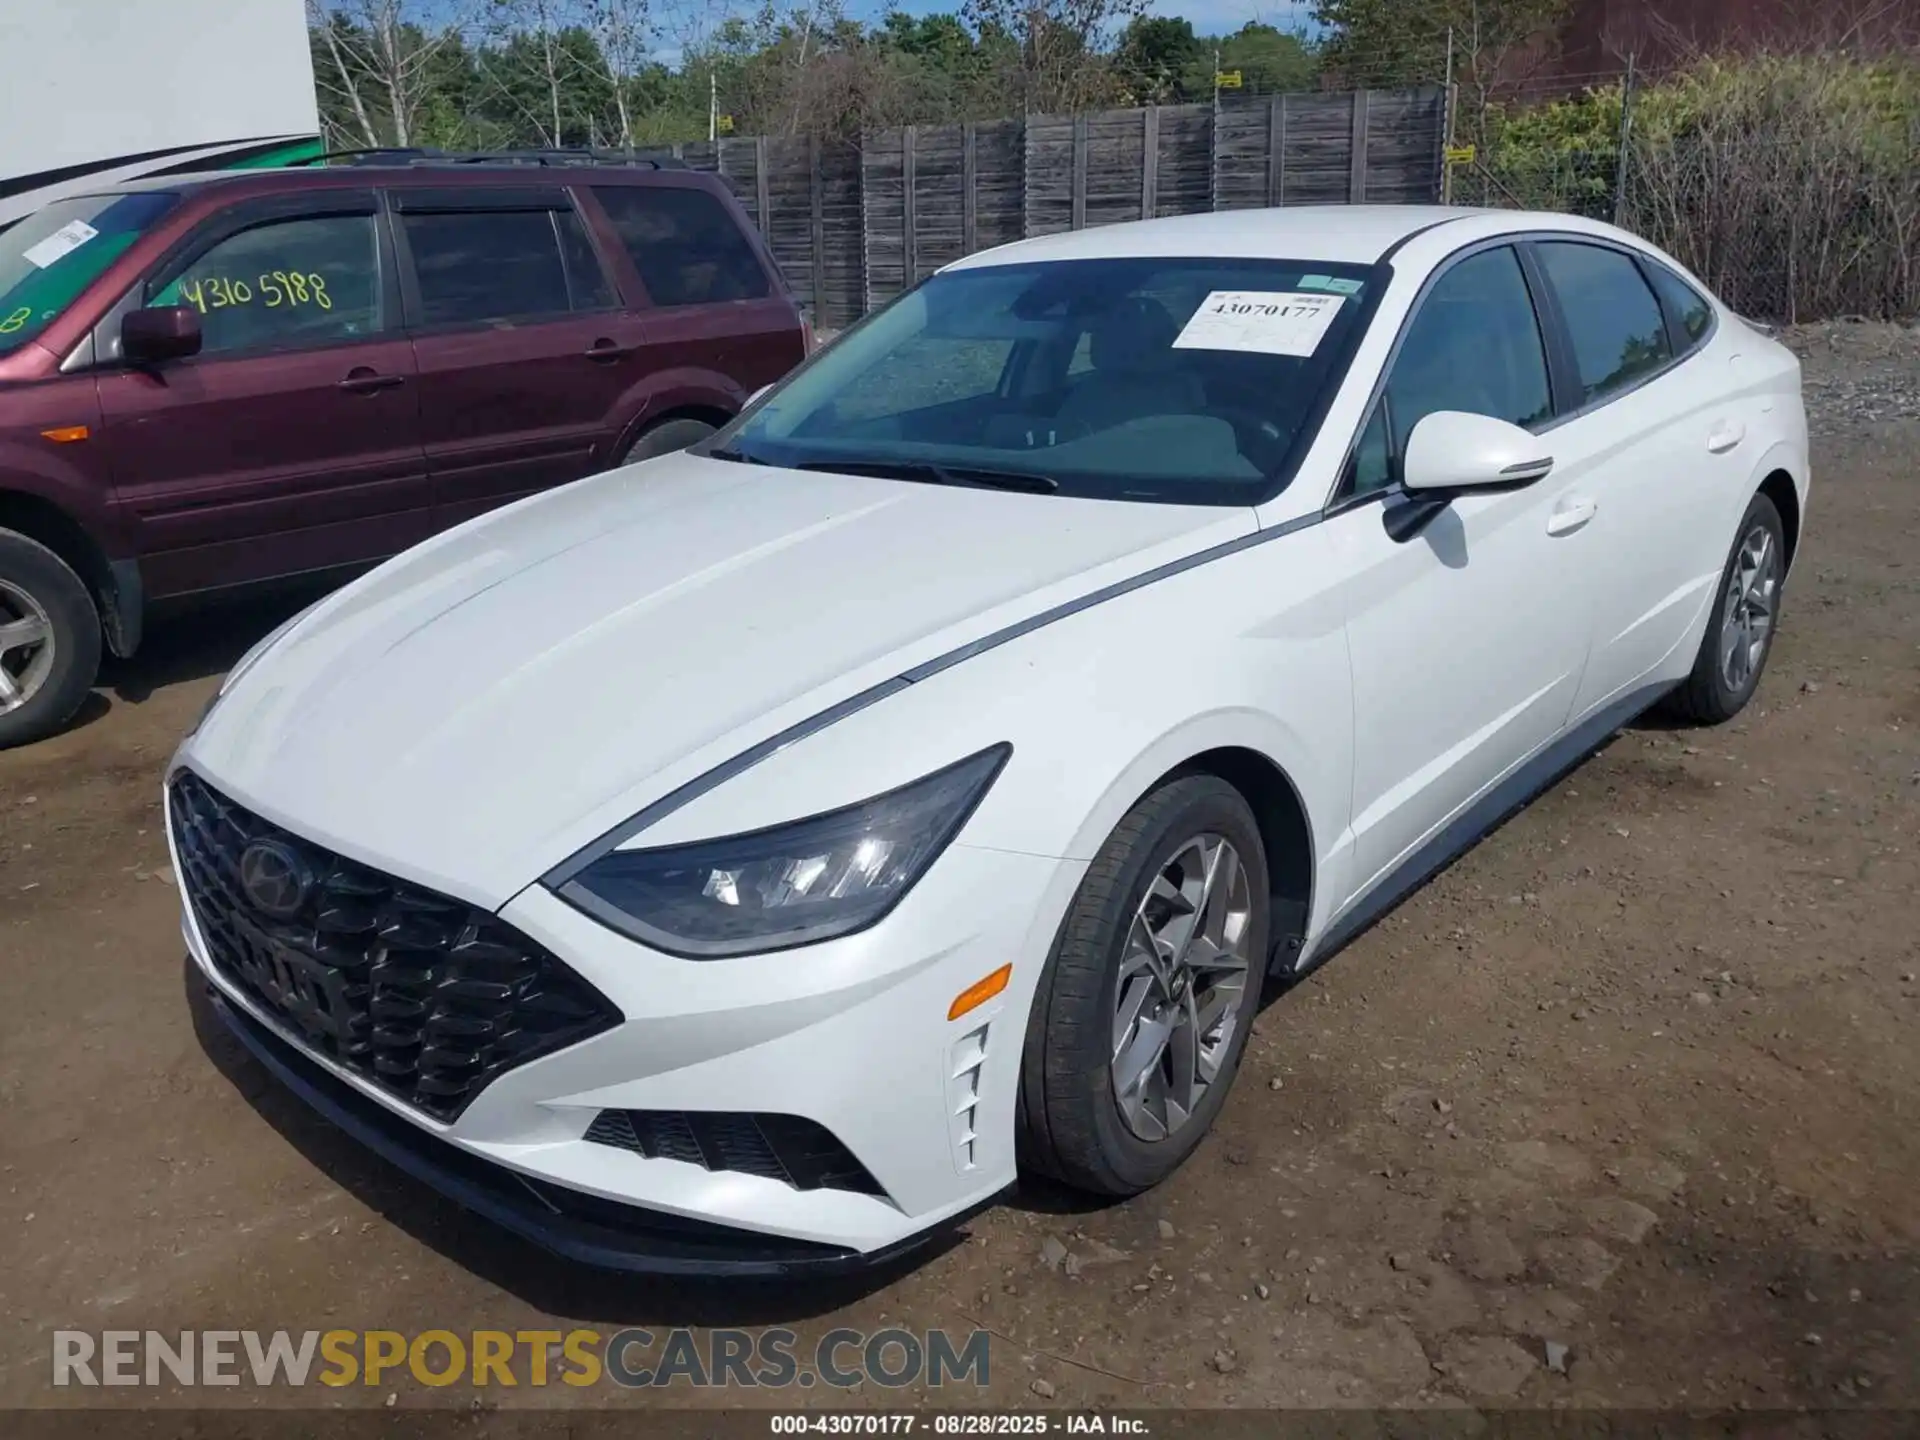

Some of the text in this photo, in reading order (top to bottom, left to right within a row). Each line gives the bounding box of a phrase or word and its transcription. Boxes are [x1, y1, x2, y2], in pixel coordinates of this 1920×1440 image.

[179, 271, 332, 313] 4310 5988
[1211, 303, 1320, 318] 43070177
